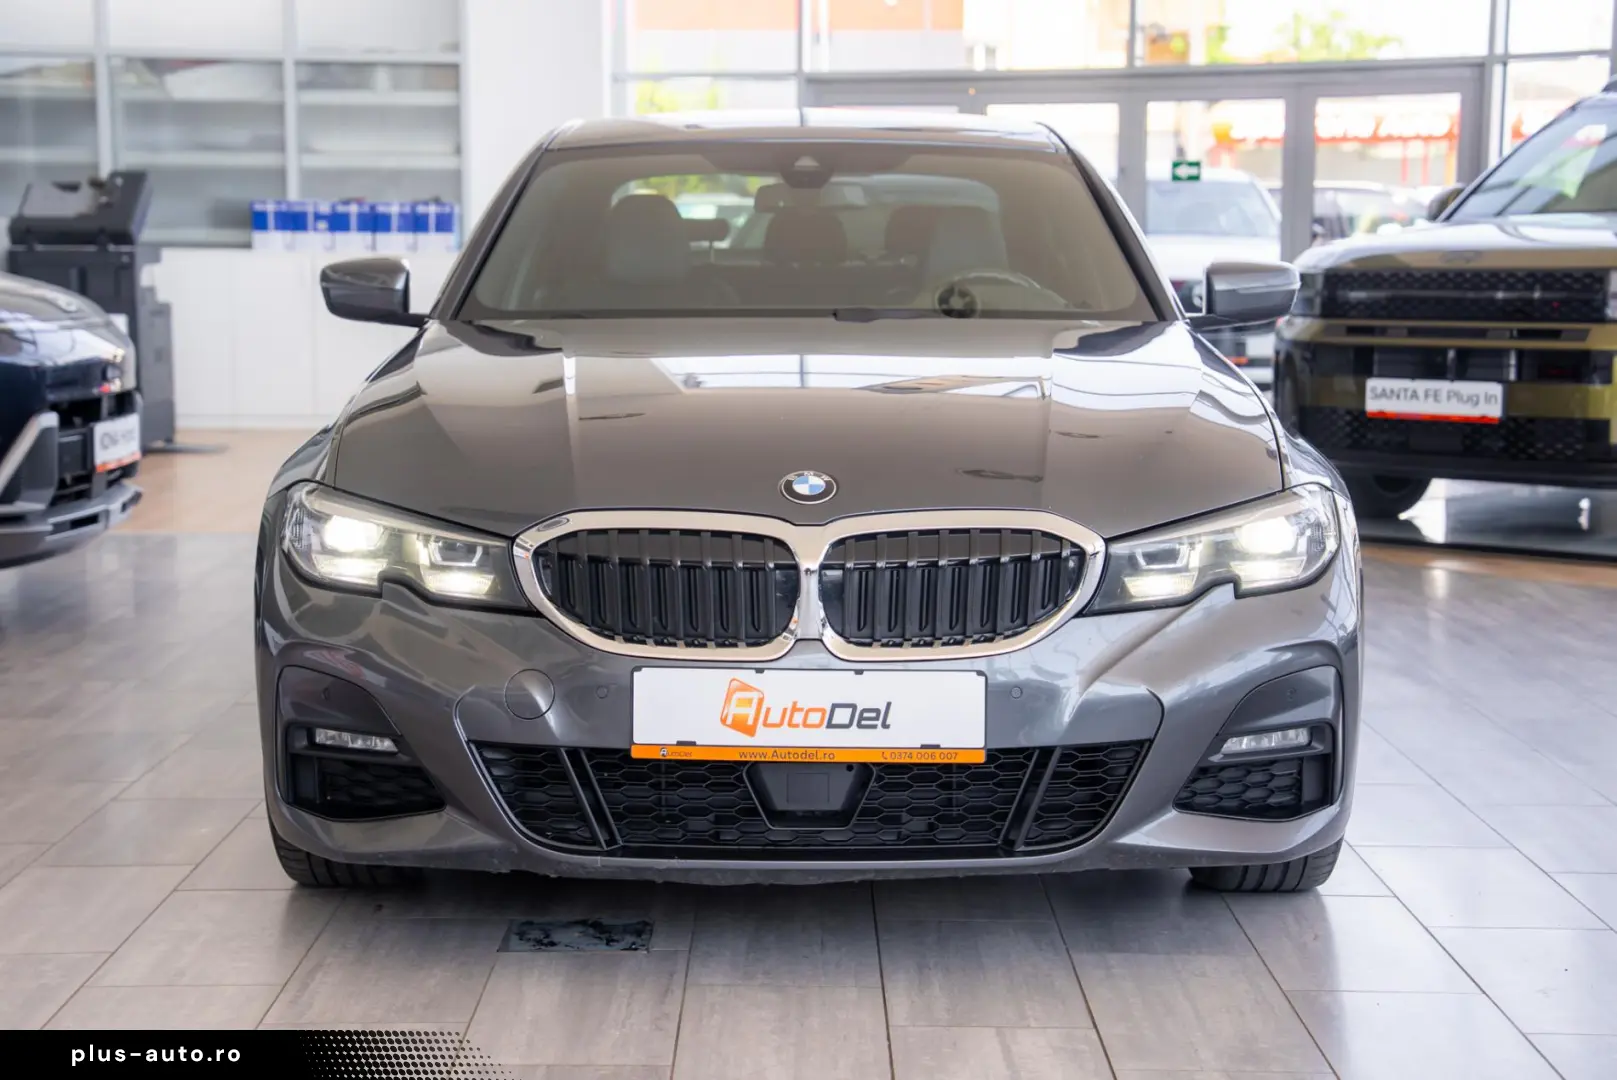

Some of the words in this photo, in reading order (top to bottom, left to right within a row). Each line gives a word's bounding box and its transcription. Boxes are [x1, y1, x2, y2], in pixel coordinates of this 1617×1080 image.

[1369, 386, 1420, 401] SANTA
[1424, 388, 1443, 403] FE
[1447, 389, 1480, 407] Plug
[723, 689, 892, 730] AutoDel
[739, 749, 836, 760] www.Autodel.ro
[890, 751, 913, 760] 0374
[916, 752, 936, 760] 006
[939, 752, 958, 760] 007
